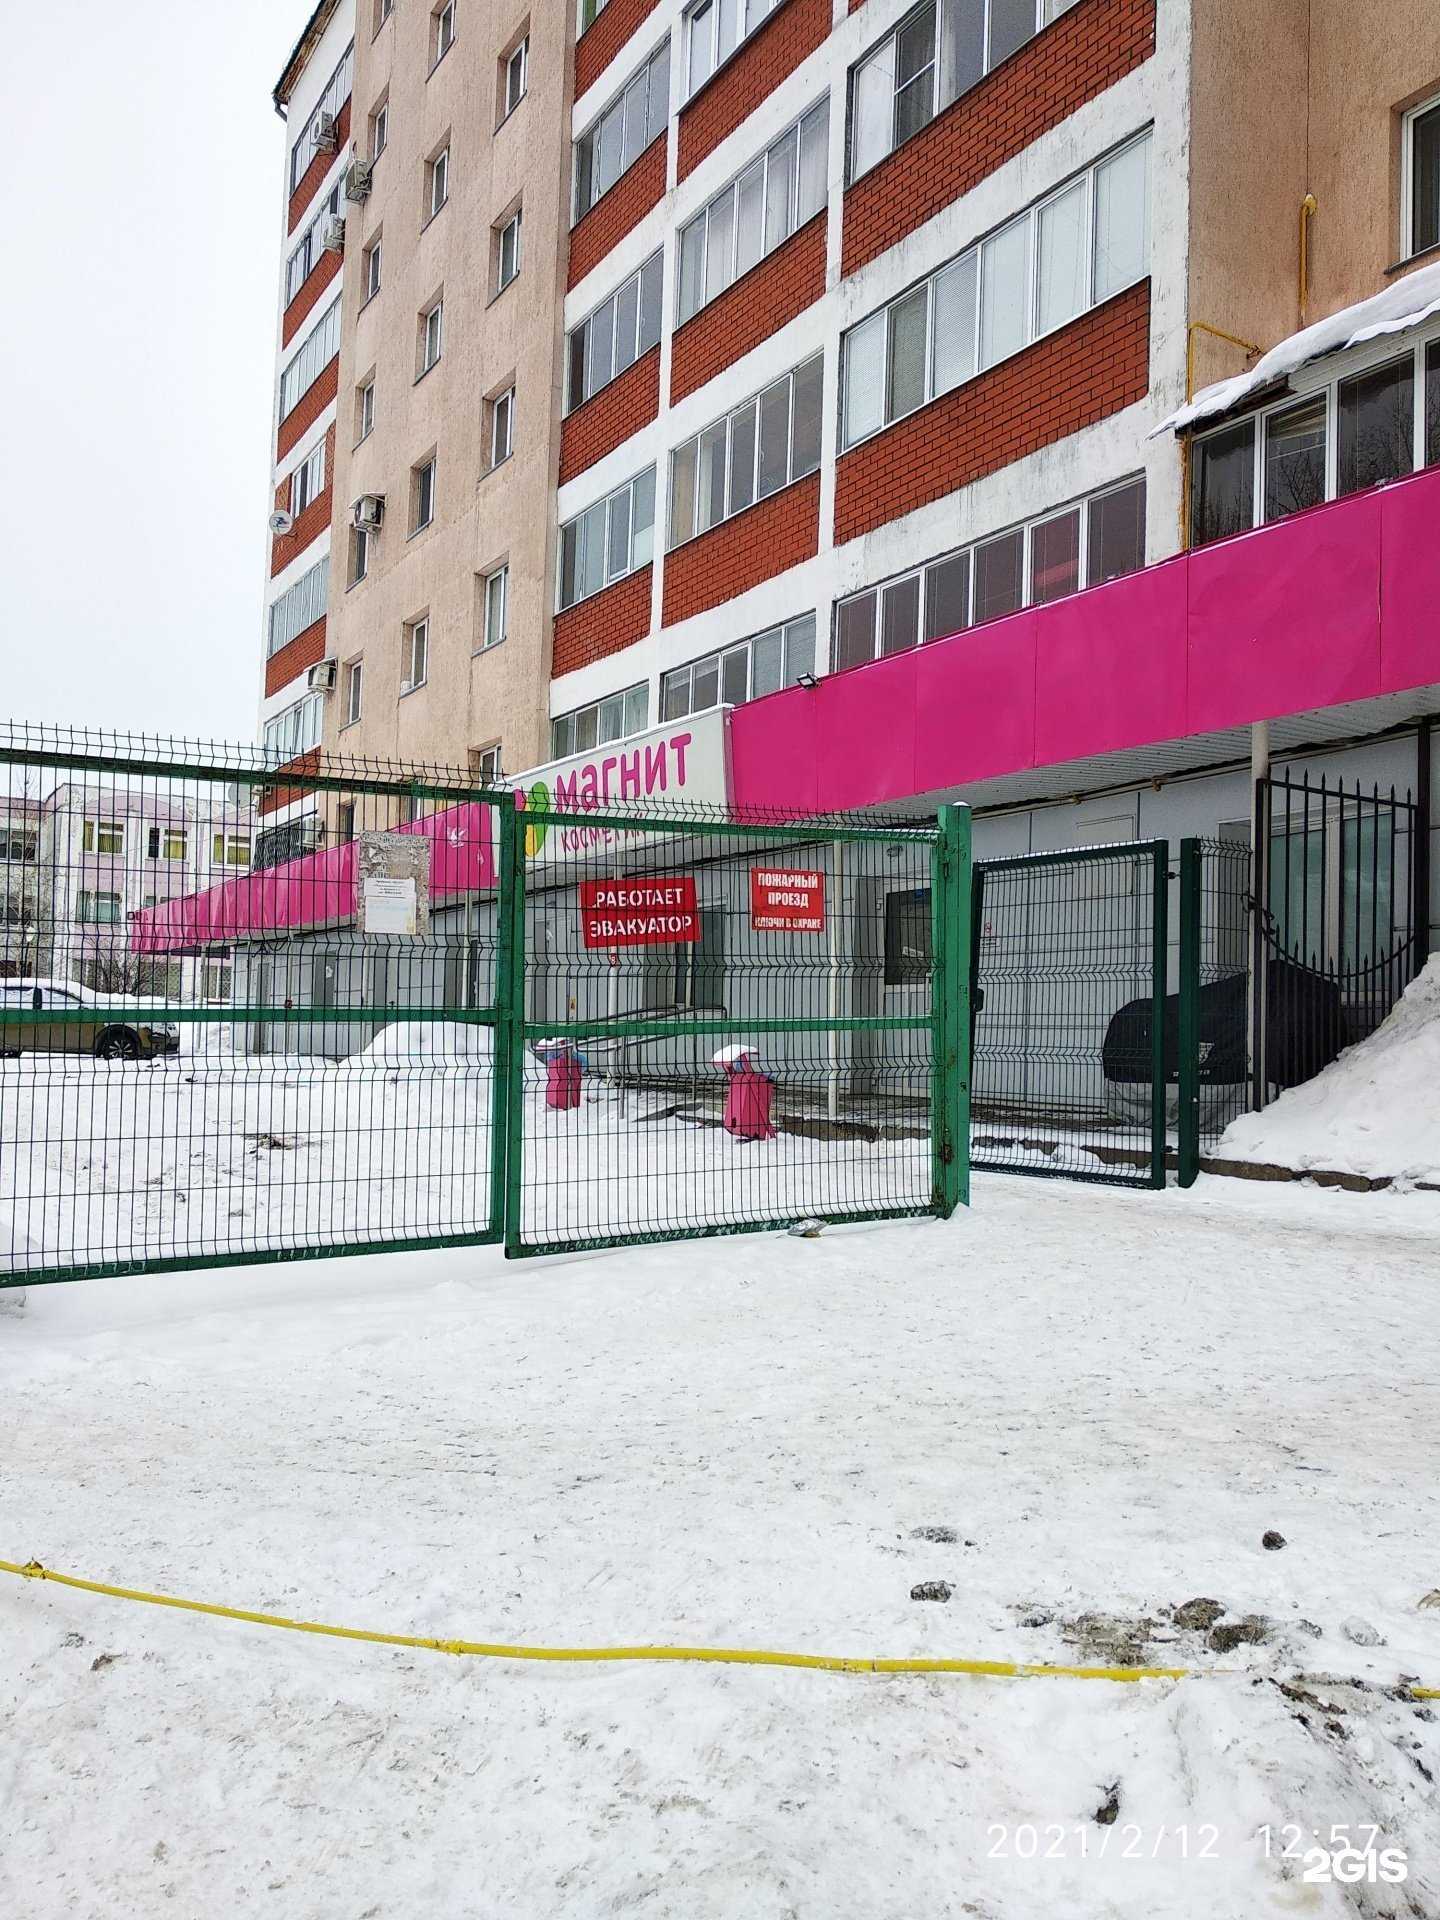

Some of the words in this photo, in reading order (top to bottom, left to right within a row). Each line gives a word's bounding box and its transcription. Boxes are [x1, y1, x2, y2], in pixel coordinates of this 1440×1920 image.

[758, 873, 818, 889] ПОЖАРНЫЙ
[596, 888, 683, 908] РАБОТАЕТ
[768, 892, 809, 909] ПРОЕЗД
[590, 916, 692, 938] ЭВАКУАТОР
[785, 917, 792, 928] В
[793, 918, 822, 929] ОХРАНЕ
